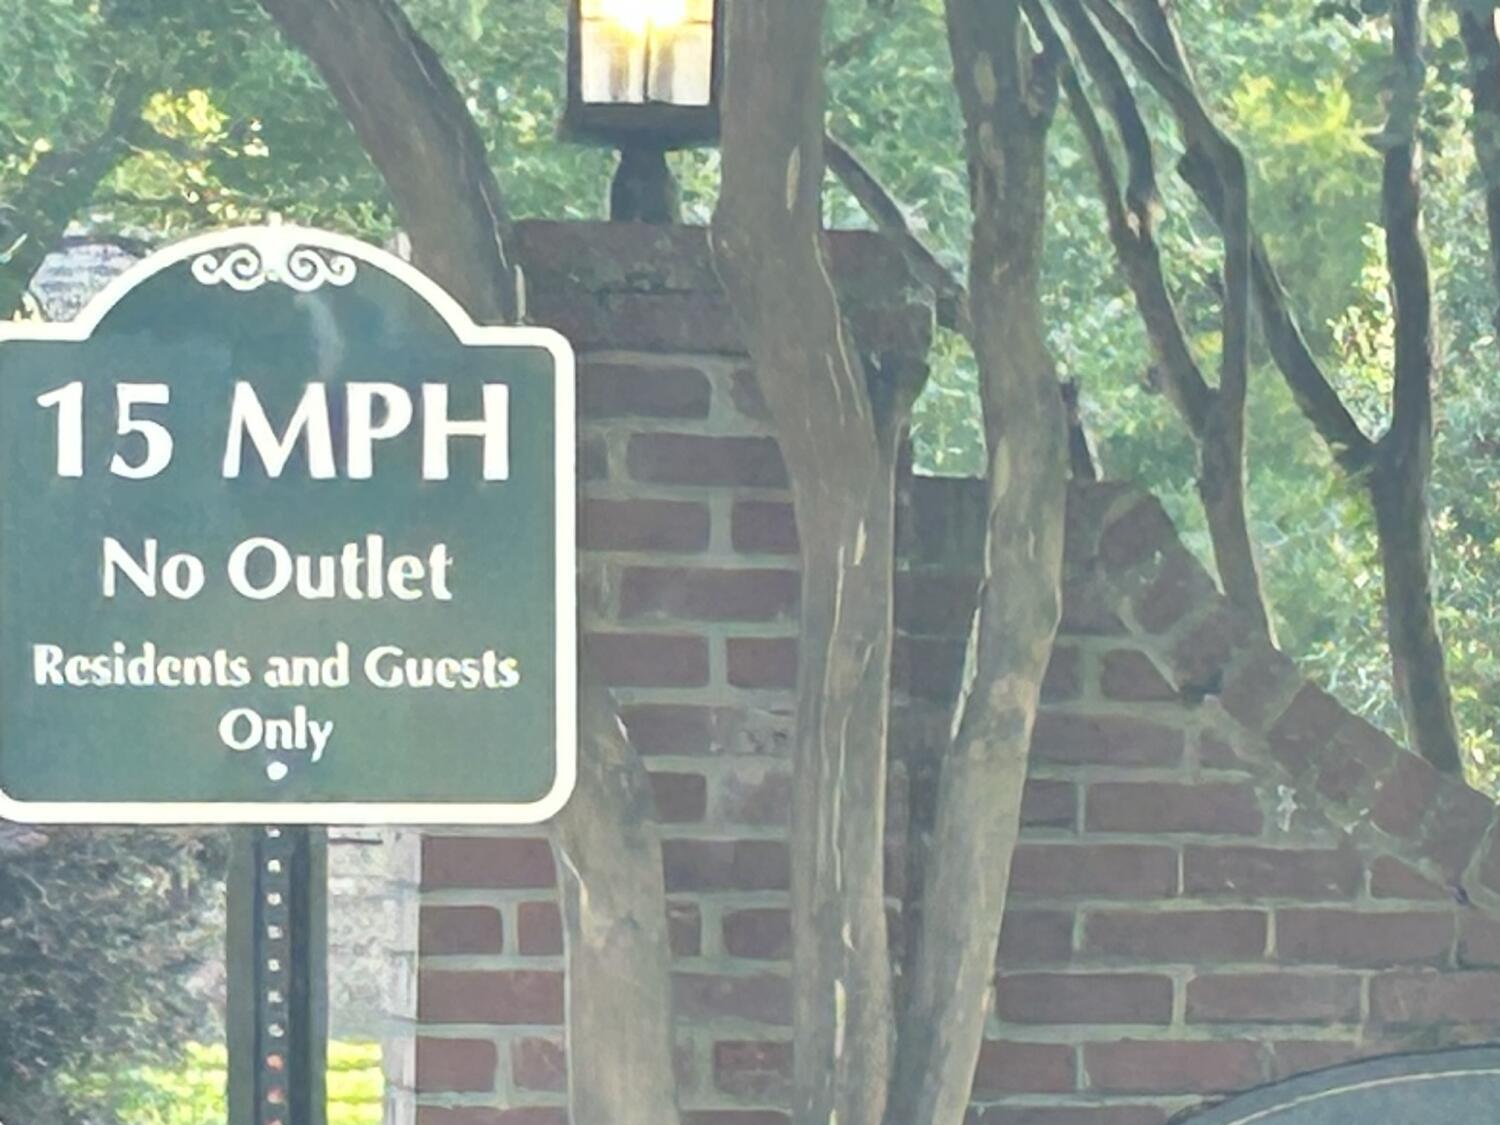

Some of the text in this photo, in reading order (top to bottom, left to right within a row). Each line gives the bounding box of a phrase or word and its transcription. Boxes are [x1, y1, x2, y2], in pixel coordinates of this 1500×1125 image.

[36, 381, 510, 481] 15 MPH
[102, 534, 454, 601] No Outlet
[33, 641, 521, 689] Residents and Guests
[218, 705, 334, 762] Only
